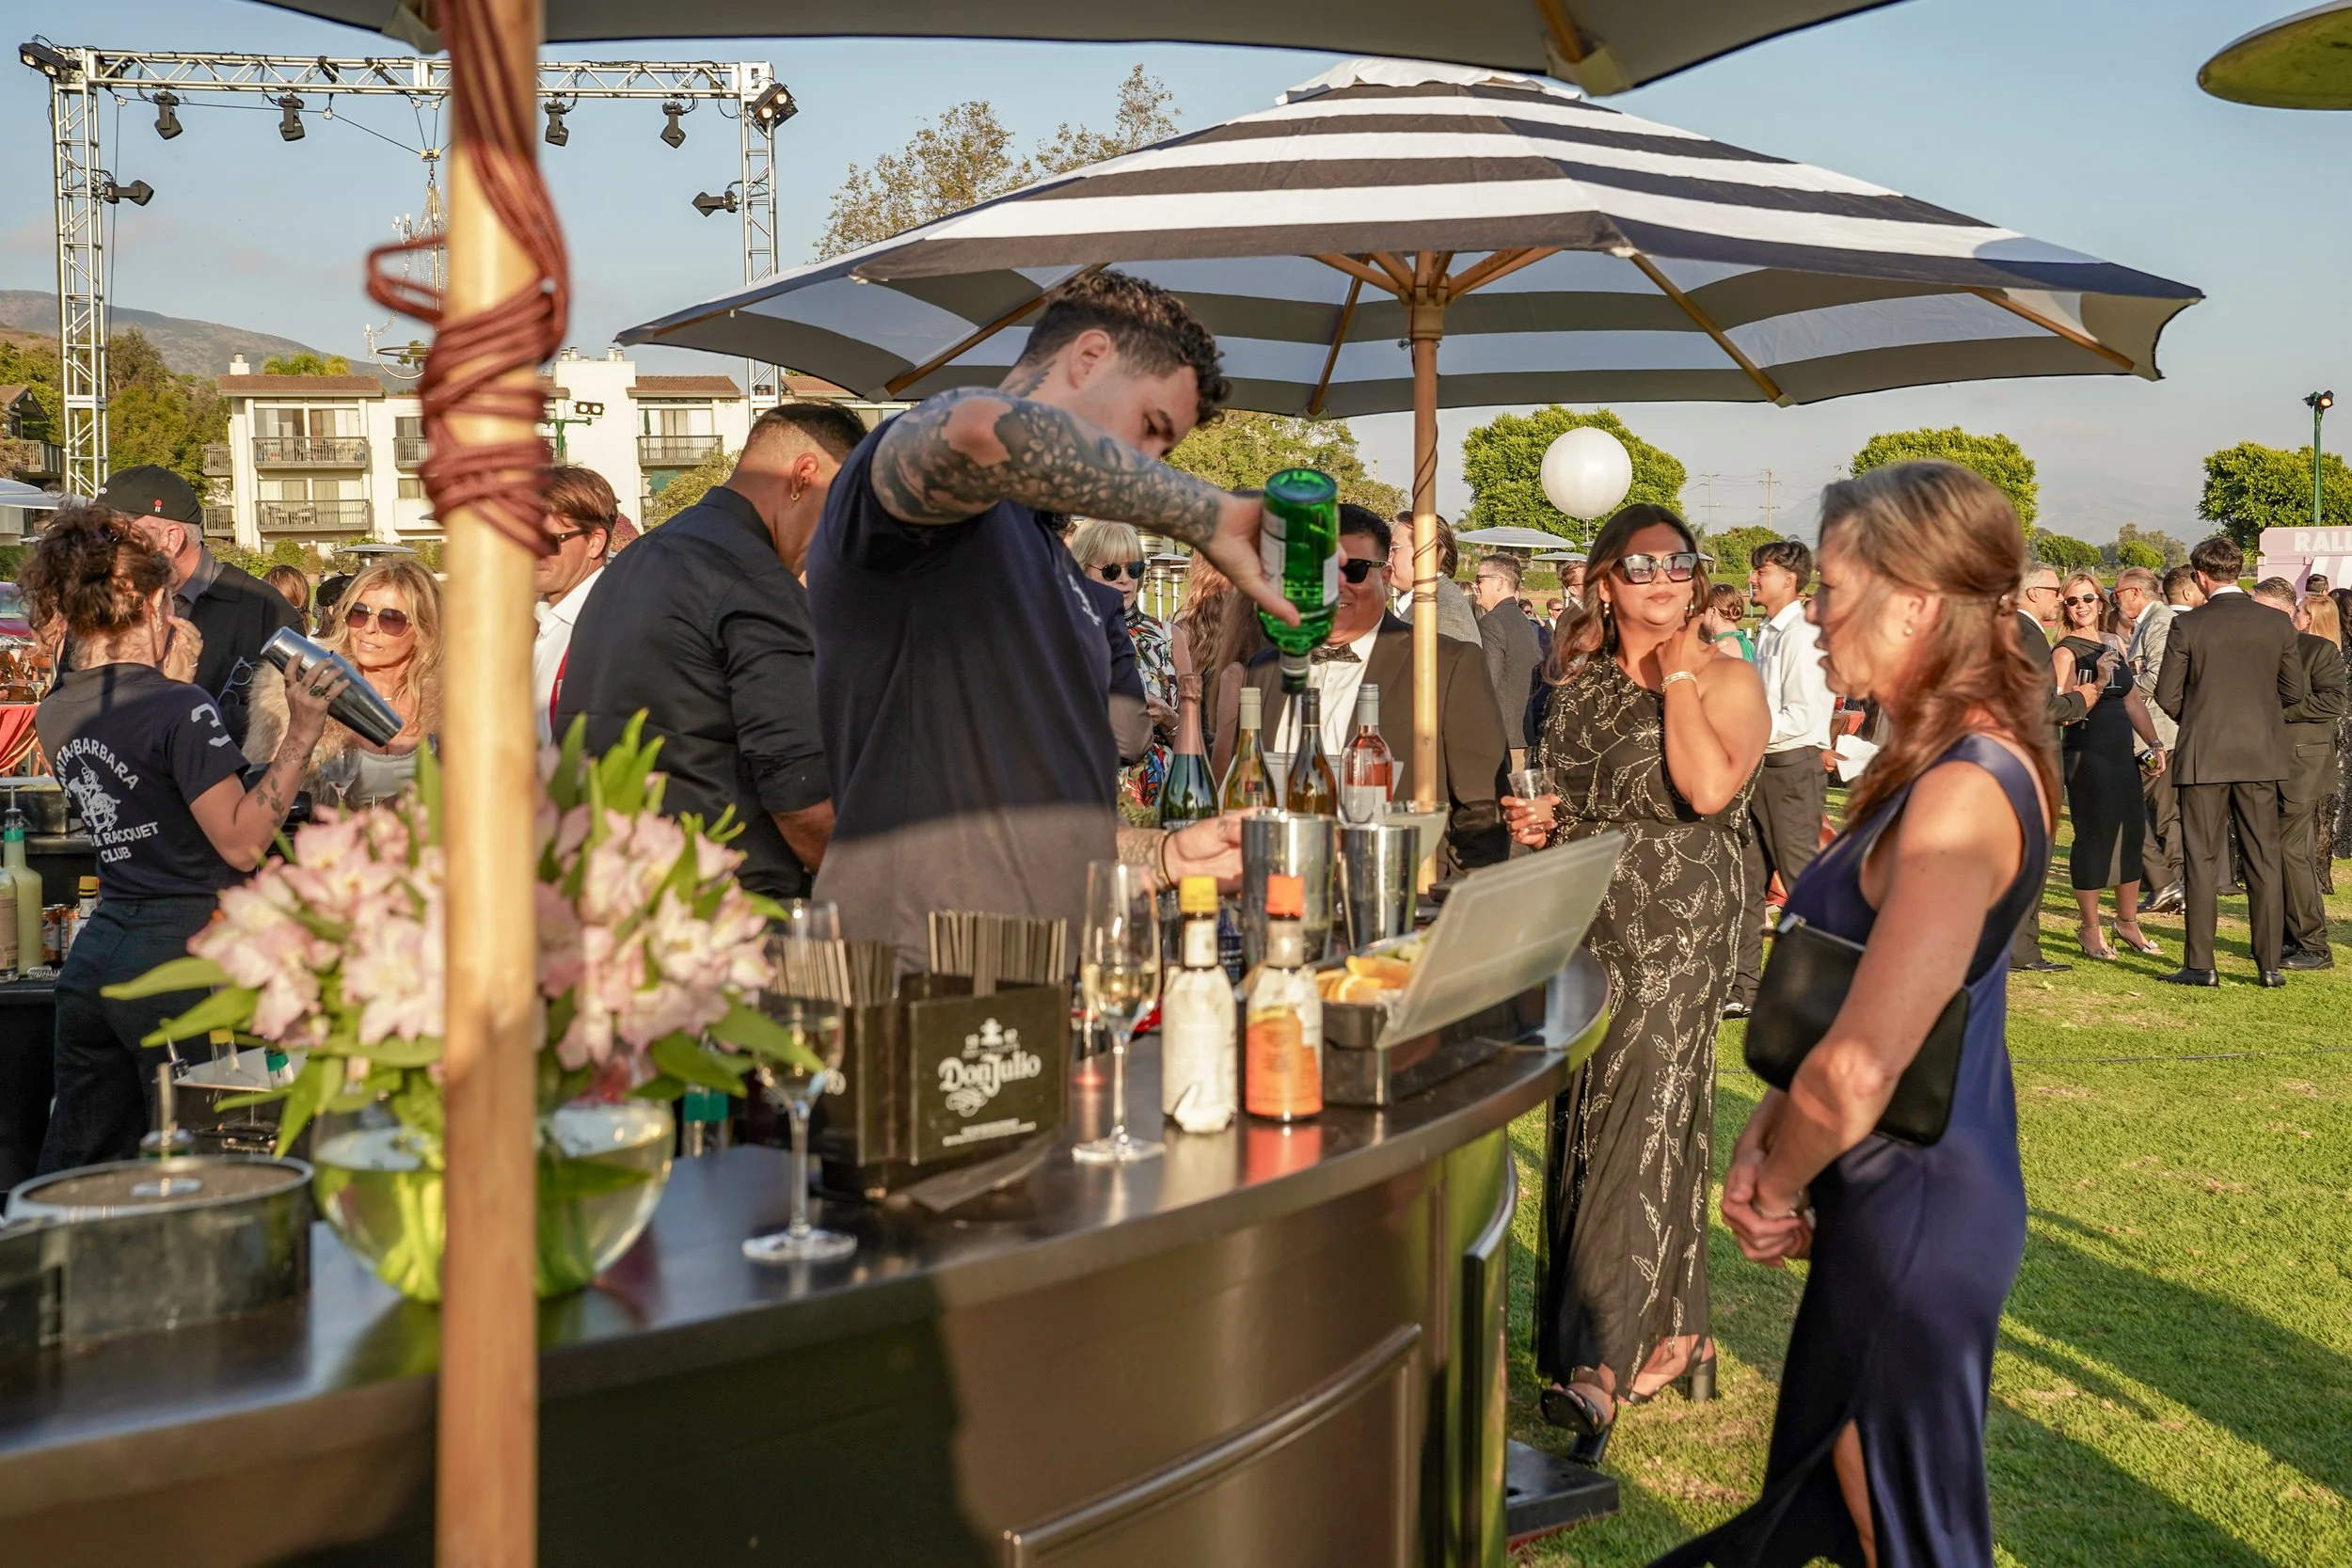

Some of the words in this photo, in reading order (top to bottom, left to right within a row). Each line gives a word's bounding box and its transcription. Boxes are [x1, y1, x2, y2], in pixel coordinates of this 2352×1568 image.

[72, 737, 139, 790] BARBARA
[102, 821, 159, 846] RACQUET
[101, 846, 132, 863] CLUB
